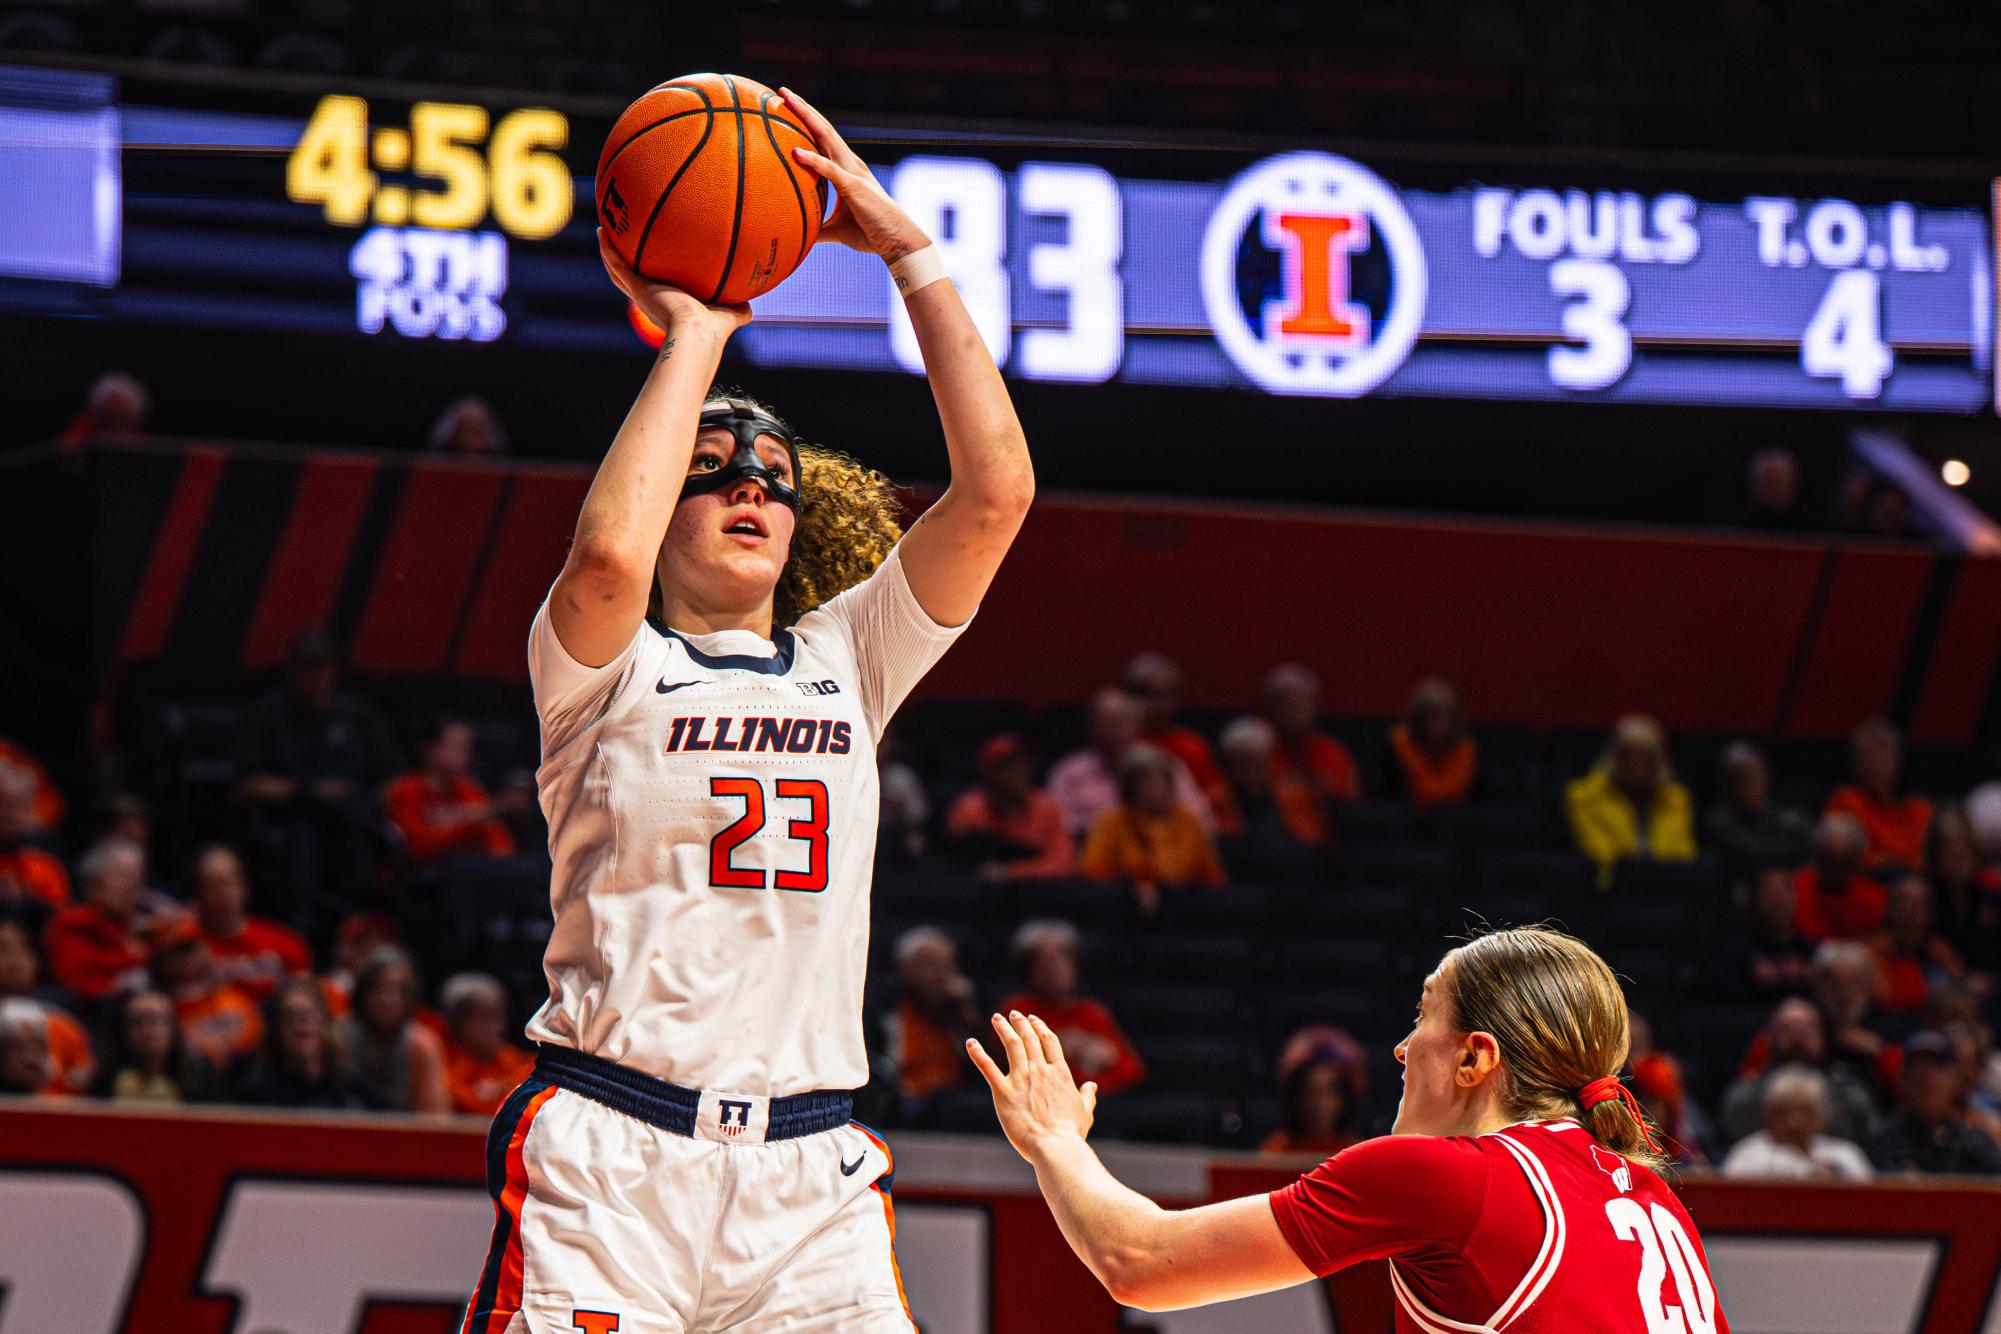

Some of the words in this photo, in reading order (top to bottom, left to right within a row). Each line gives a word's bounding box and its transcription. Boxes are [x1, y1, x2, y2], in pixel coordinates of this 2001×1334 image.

[287, 95, 573, 239] 4:56
[1473, 186, 1697, 264] FOULS
[1746, 196, 1949, 271] T.O.L.
[349, 227, 508, 299] 4TH
[890, 155, 1122, 383] 83
[1548, 259, 1632, 389] 3
[1803, 269, 1893, 398] 4
[664, 716, 851, 755] ILLINOIS
[709, 777, 829, 893] 23
[1604, 1197, 1718, 1334] 20
